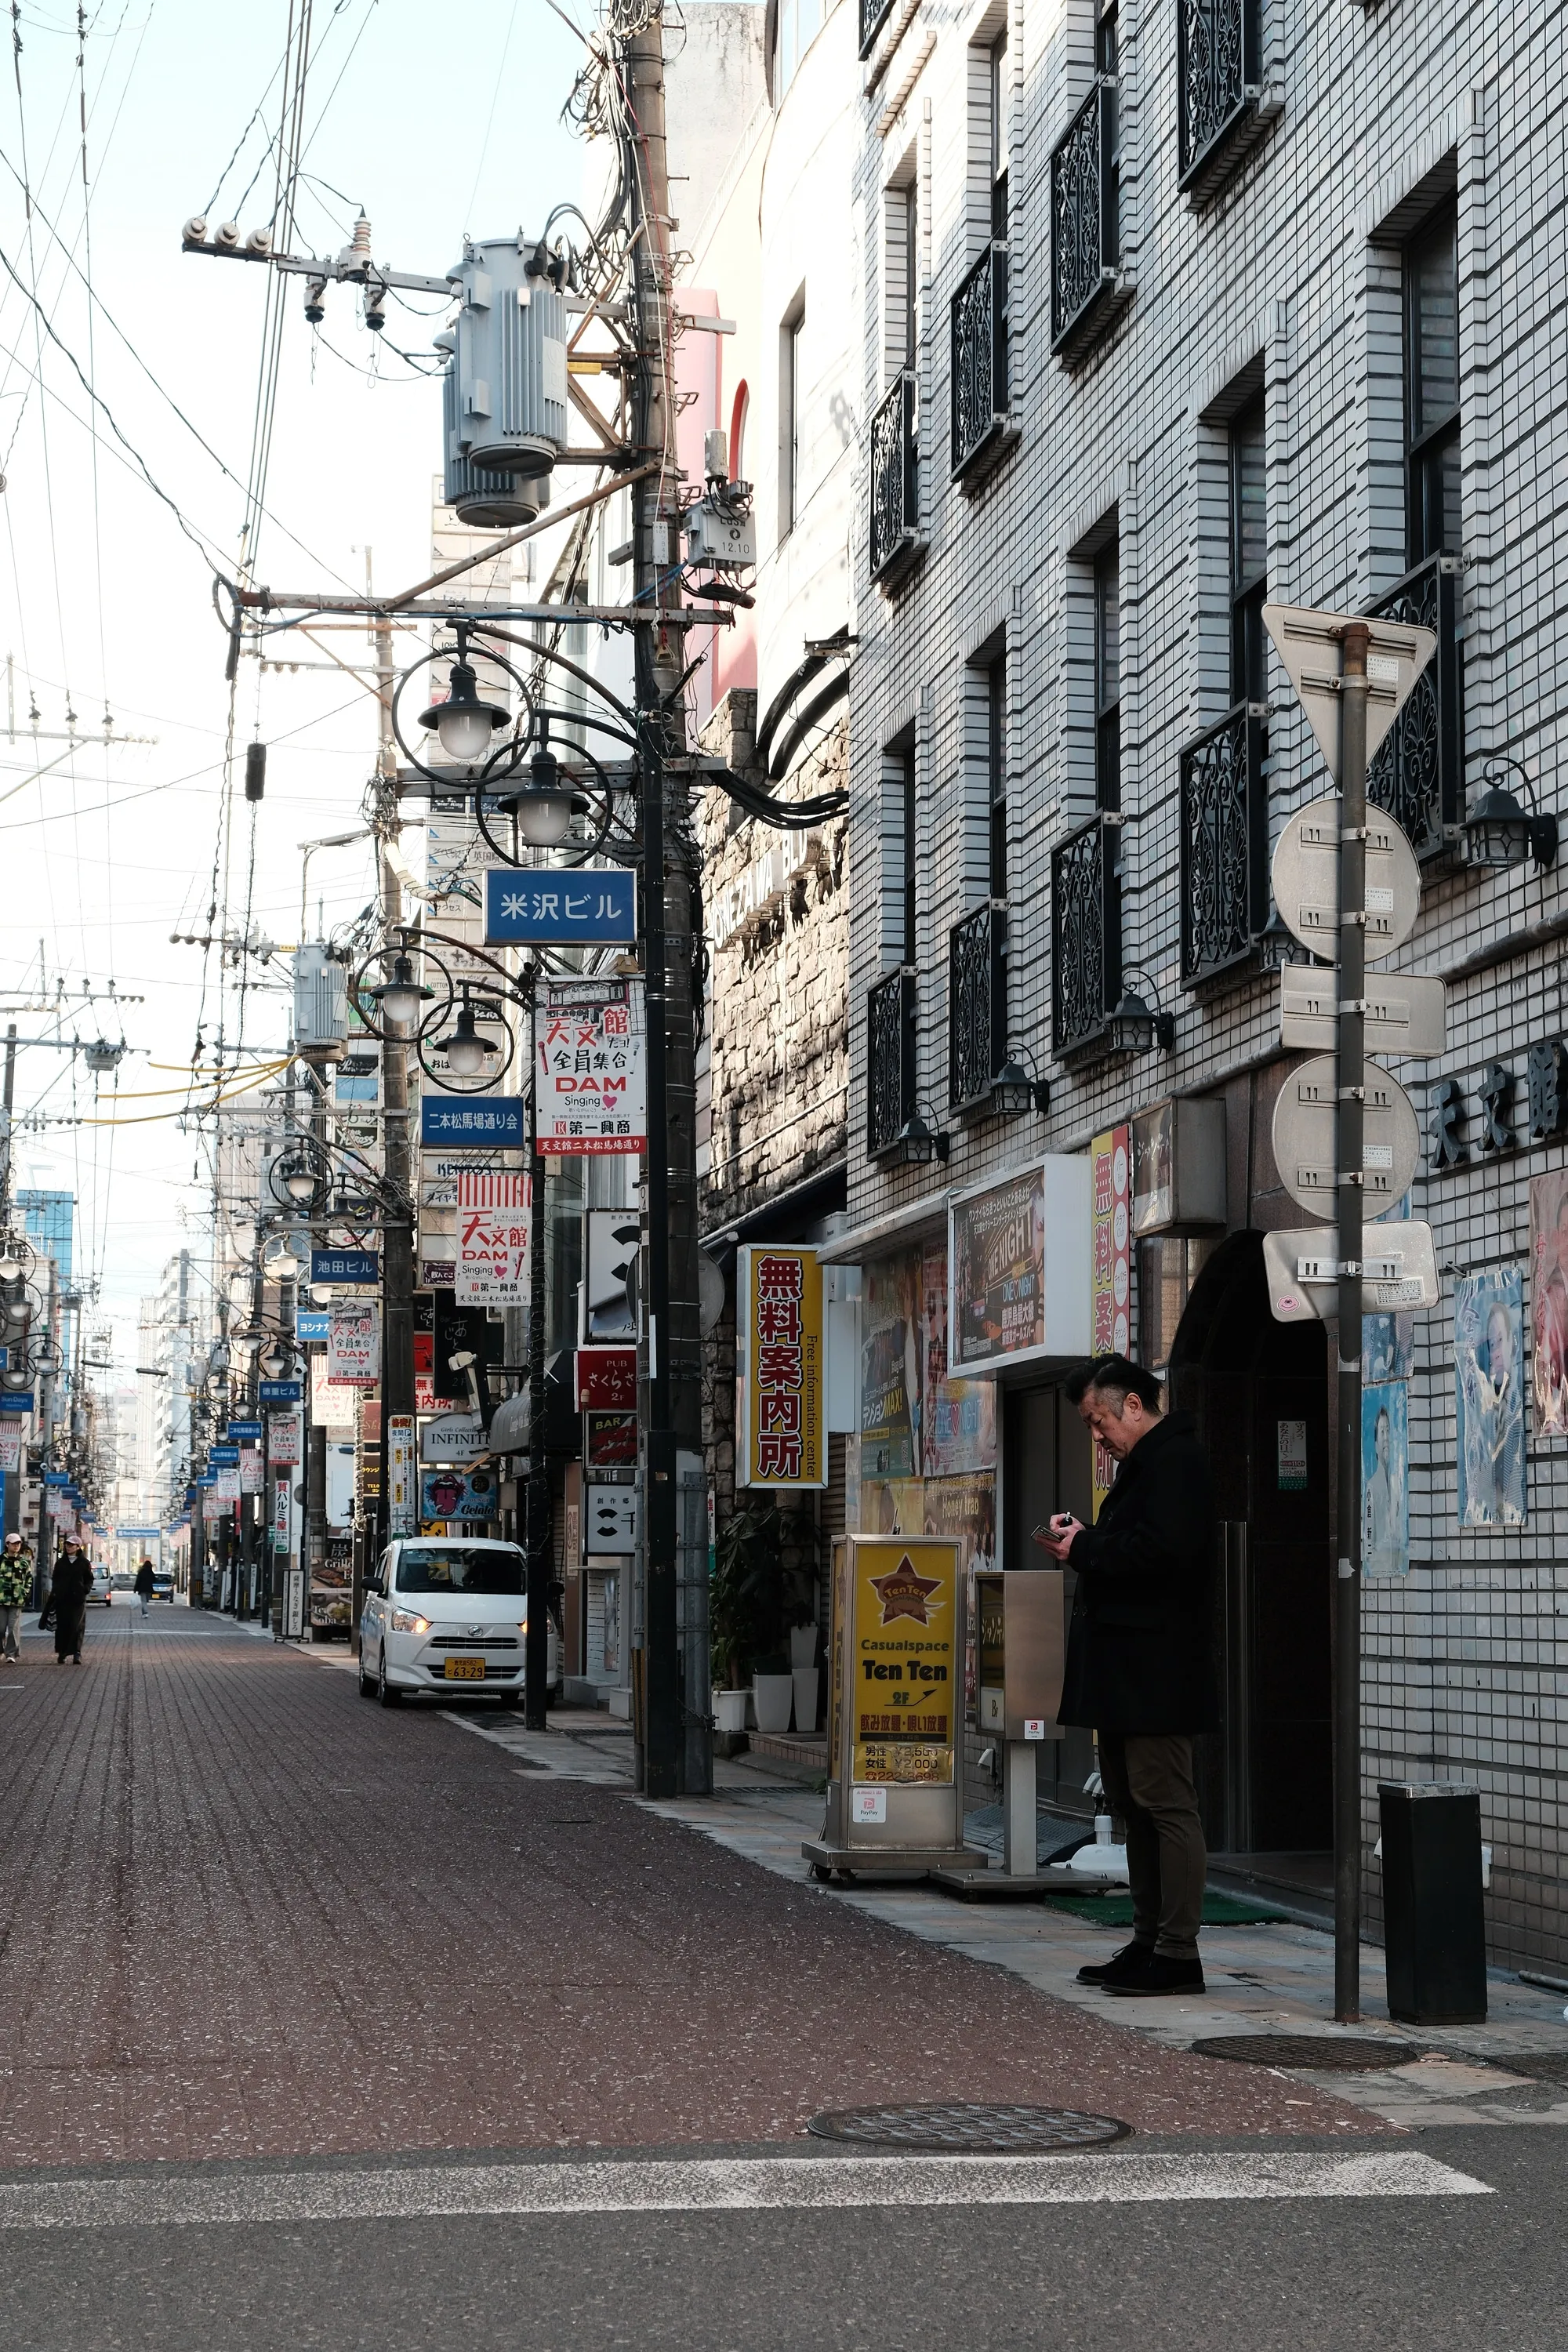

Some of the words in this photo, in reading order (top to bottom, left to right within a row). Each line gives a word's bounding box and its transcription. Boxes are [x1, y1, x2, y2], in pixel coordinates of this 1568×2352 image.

[722, 542, 750, 554] 12.10
[500, 893, 622, 920] 米沢ビル
[546, 1008, 627, 1048] 天文館
[553, 1049, 627, 1074] 全員集合
[555, 1076, 626, 1092] DAM
[564, 1094, 601, 1107] Singing
[428, 1112, 518, 1130] 二本松馬場通り会
[569, 1120, 630, 1135] 第一興商
[541, 1139, 641, 1152] 天文館二本松馬場通り
[462, 1210, 528, 1247] 天文館
[988, 1245, 999, 1281] ONE
[999, 1200, 1034, 1272] NIGHT
[463, 1250, 508, 1261] DAM
[317, 1260, 373, 1274] 池田ビル
[463, 1264, 492, 1276] Singing
[481, 1283, 517, 1292] 第一興商
[333, 1319, 372, 1338] 天文館
[336, 1338, 370, 1348] 全員集合
[806, 1335, 818, 1361] Free
[757, 1255, 804, 1479] 無料案内所
[611, 1392, 625, 1401] 2F
[806, 1364, 818, 1436] information
[595, 1417, 621, 1430] BAR
[806, 1438, 817, 1479] center
[461, 1504, 495, 1515] Gelato
[942, 1495, 963, 1521] Honey
[884, 1587, 907, 1599] Ten
[906, 1584, 927, 1599] Ten
[861, 1639, 950, 1653] Casualspace
[454, 1667, 483, 1677] 63-29
[862, 1660, 902, 1680] Ten
[906, 1661, 948, 1681] Ten
[892, 1691, 909, 1704] 2F
[865, 1746, 887, 1757] 男性
[865, 1759, 887, 1769] 女性
